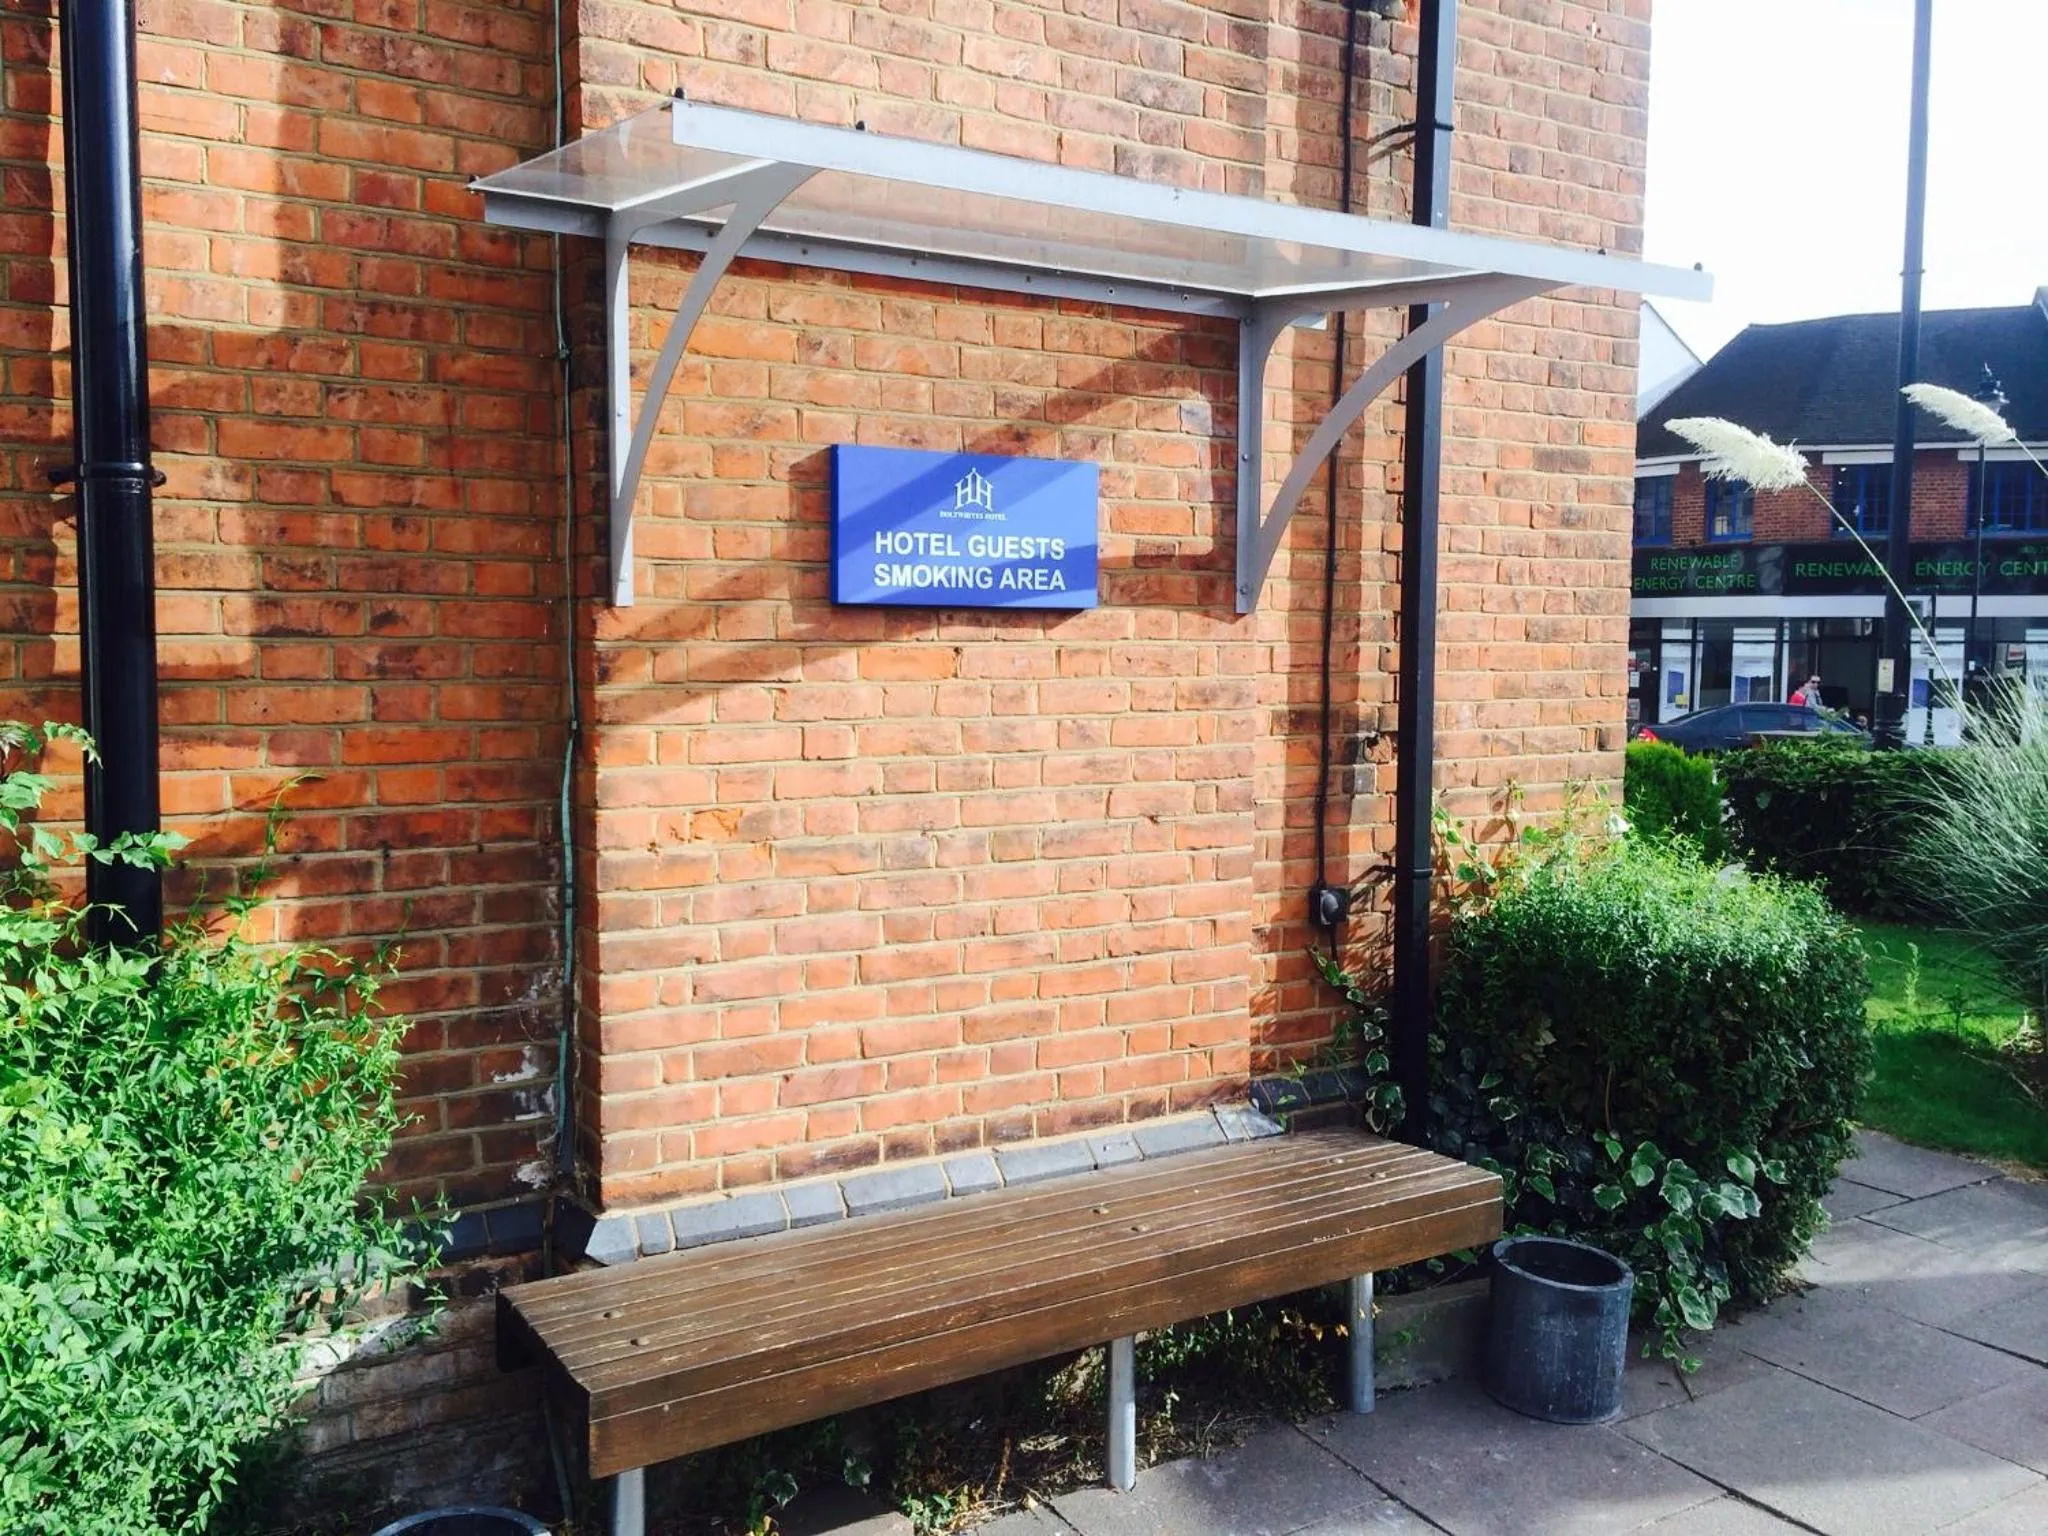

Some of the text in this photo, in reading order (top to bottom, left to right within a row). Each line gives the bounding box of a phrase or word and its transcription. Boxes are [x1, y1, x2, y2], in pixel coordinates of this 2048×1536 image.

[875, 531, 1065, 560] HOTEL GUESTS
[1650, 555, 1739, 571] RENEWABLE
[1795, 562, 1890, 577] RENEWAB
[1915, 561, 1990, 576] ENERGY
[874, 563, 1066, 591] SMOKING AREA
[1634, 574, 1756, 591] ENERGY CENTRE
